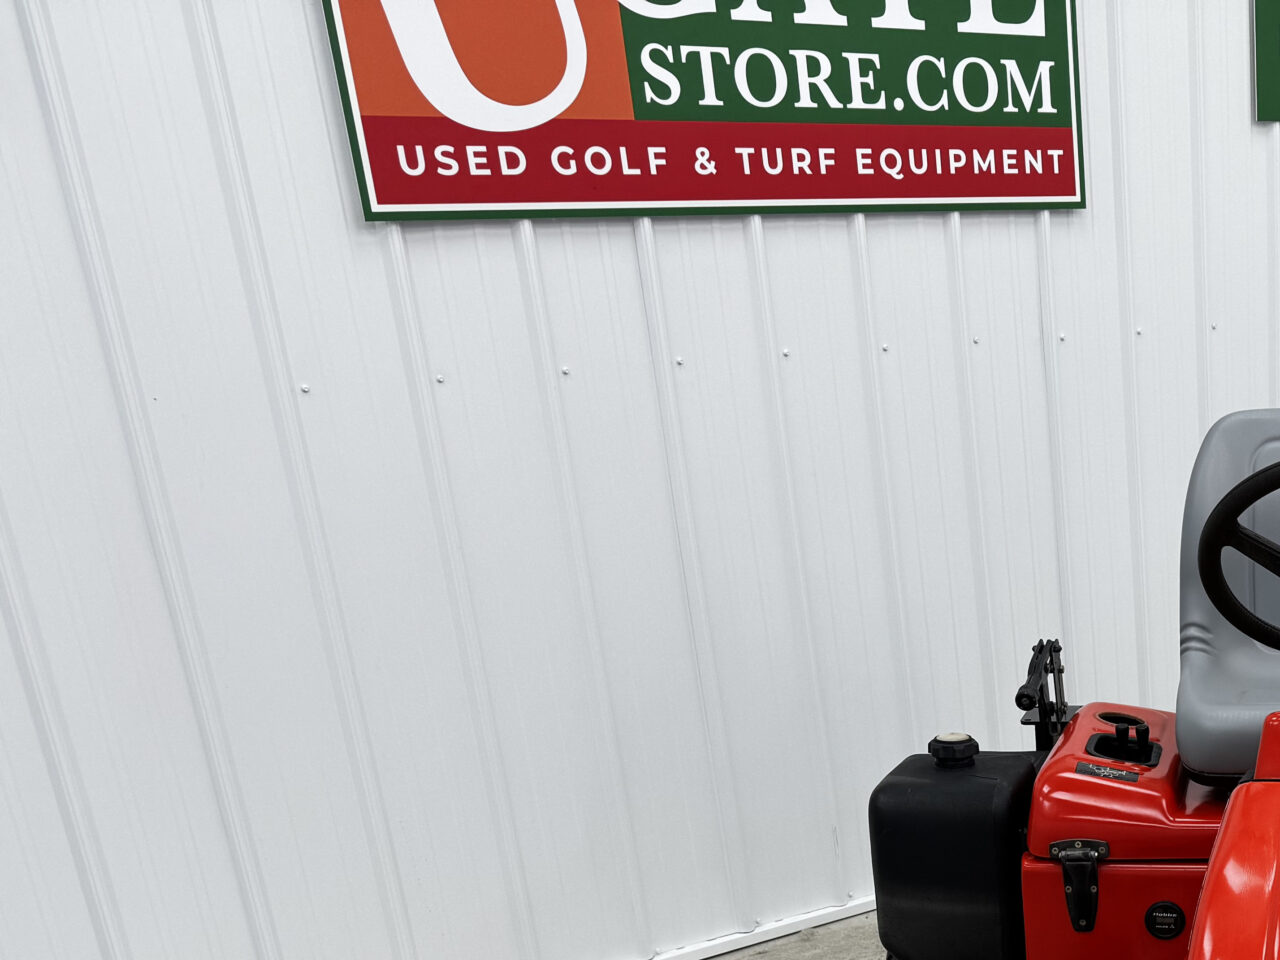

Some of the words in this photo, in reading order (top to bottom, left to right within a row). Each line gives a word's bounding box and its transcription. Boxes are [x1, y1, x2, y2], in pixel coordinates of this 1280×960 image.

[640, 42, 1058, 114] STORE.COM
[396, 144, 527, 176] USED
[550, 145, 667, 176] GOLF
[694, 146, 717, 176] &
[734, 147, 836, 175] TURF
[855, 148, 1064, 180] EQUIPMENT
